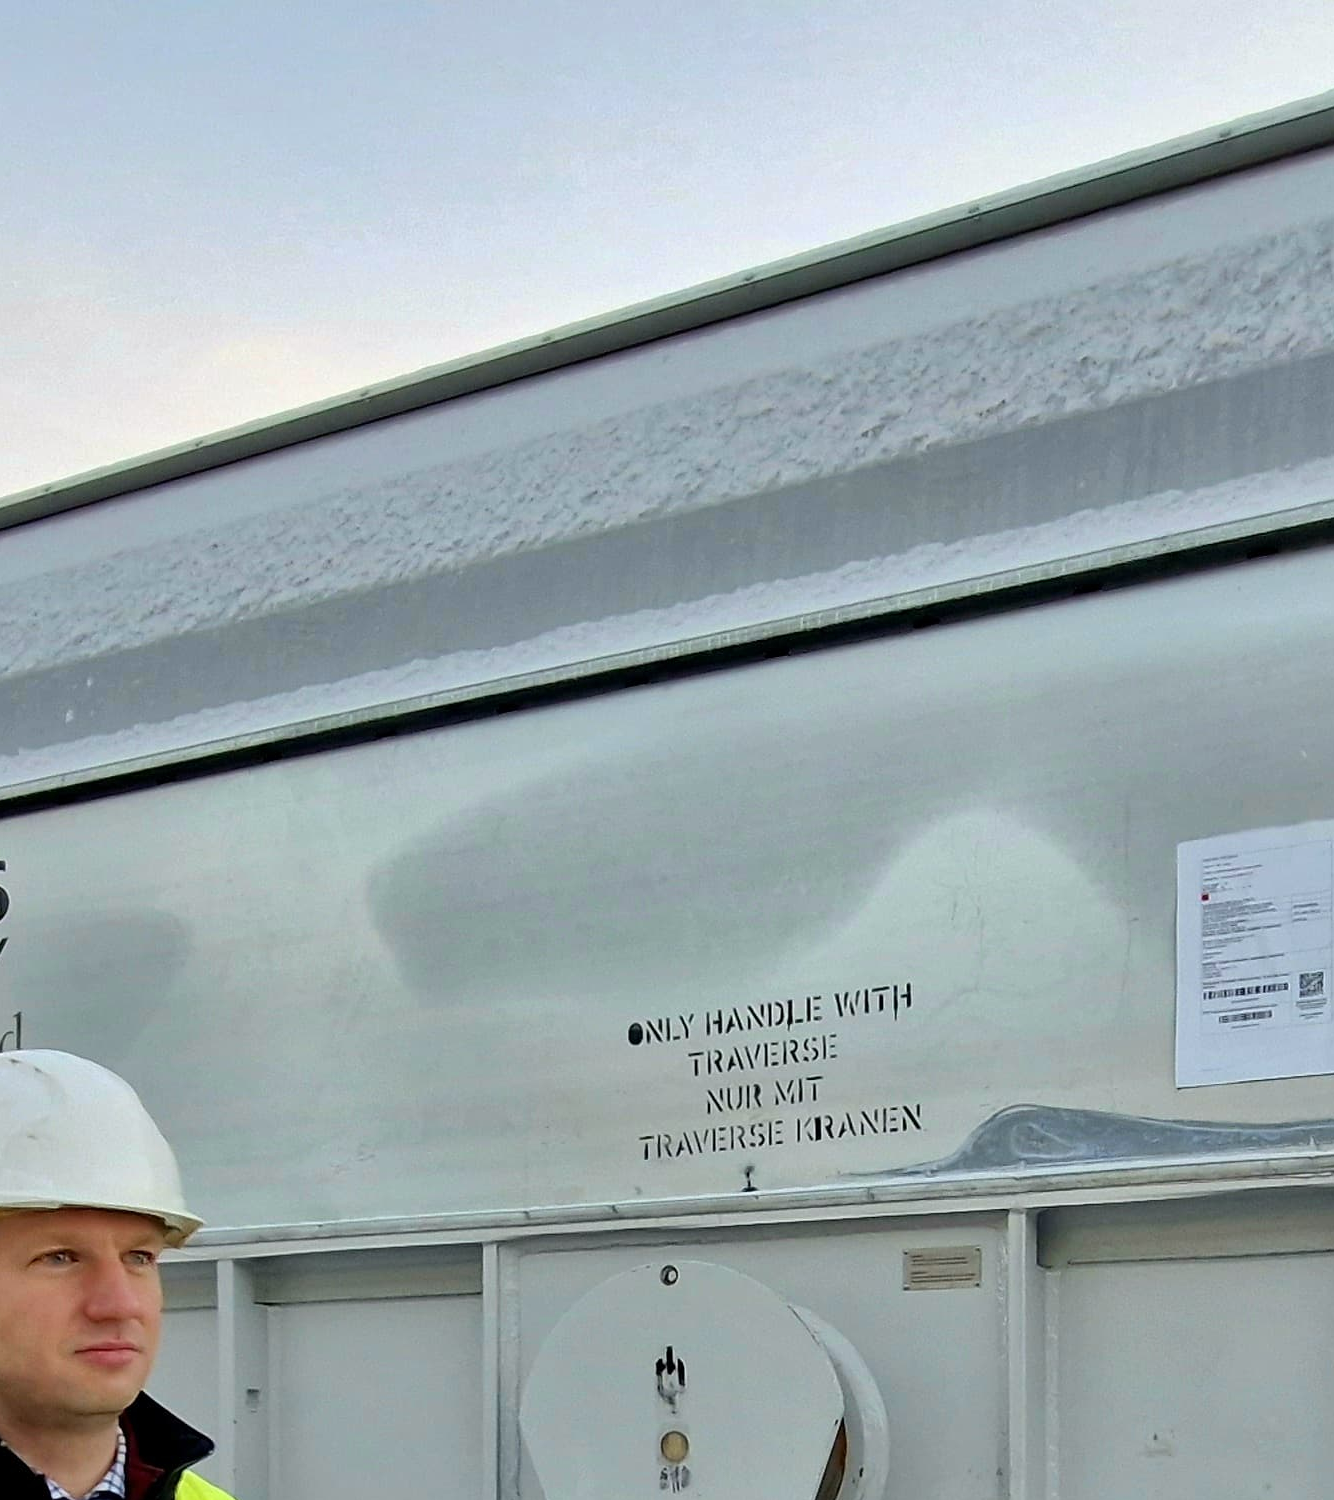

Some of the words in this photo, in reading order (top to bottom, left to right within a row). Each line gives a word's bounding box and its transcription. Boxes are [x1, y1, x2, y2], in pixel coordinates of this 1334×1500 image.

[706, 996, 823, 1036] HANDLE
[834, 982, 912, 1019] WITH
[688, 1033, 838, 1077] TRAVERSE
[707, 1083, 762, 1114] NUR
[775, 1076, 823, 1106] MIT
[639, 1120, 784, 1160] TRAVERSE
[796, 1103, 922, 1142] KRANEN
